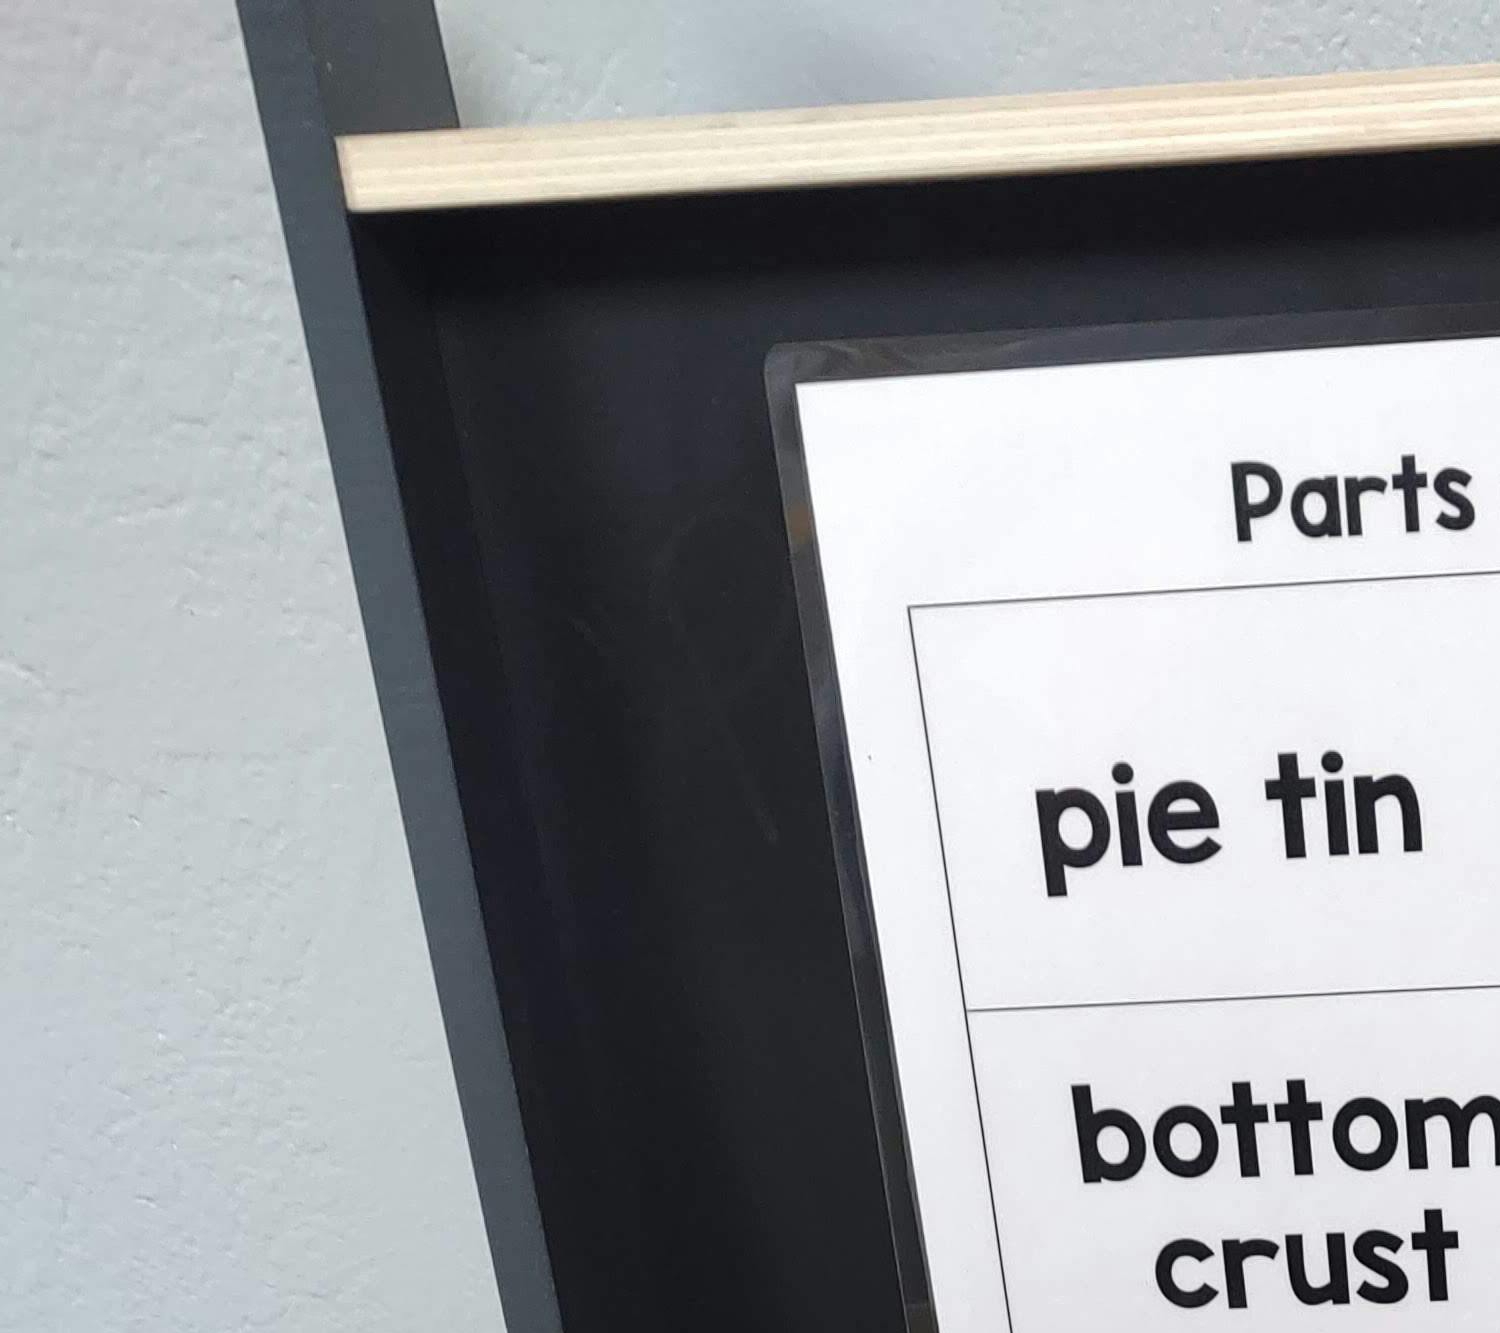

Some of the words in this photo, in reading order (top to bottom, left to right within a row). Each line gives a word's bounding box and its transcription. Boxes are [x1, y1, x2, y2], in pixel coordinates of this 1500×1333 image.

[1231, 455, 1475, 542] Parts
[1036, 763, 1222, 897] pie
[1265, 751, 1423, 859] tin
[1155, 1209, 1459, 1309] crust
